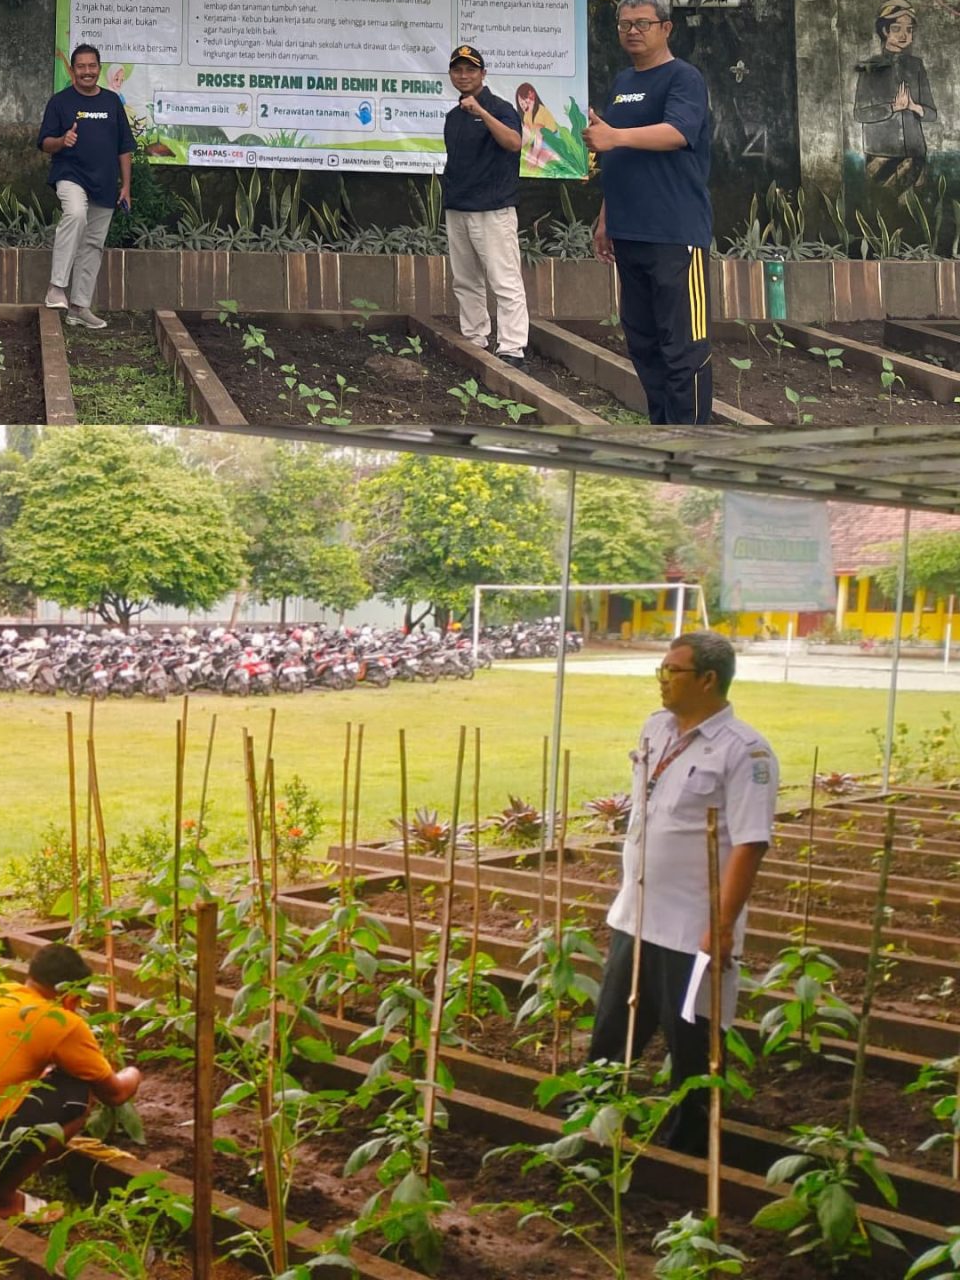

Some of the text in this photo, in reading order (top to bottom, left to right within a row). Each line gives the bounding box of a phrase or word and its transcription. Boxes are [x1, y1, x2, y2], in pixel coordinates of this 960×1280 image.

[116, 4, 170, 14] bukan tanaman
[272, 4, 298, 12] tumbuh
[490, 0, 568, 10] mengajarkan kita rendah
[104, 17, 157, 26] pakai bukan
[486, 24, 511, 32] tumbuh
[534, 26, 562, 35] biasanya
[133, 44, 146, 52] kita
[146, 44, 178, 52] bersama
[238, 51, 256, 60] tetap
[506, 49, 530, 58] bentuk
[494, 61, 516, 70] adalah
[197, 73, 444, 95] PROSES BERTANI DARI BENIH KE PIRING
[157, 100, 163, 114] 1
[212, 106, 229, 114] Bibit
[260, 104, 350, 118] 2 Perawatan tanaman
[384, 107, 392, 121] 3
[420, 110, 438, 119] Hasil
[193, 150, 227, 158] #SMAPAS
